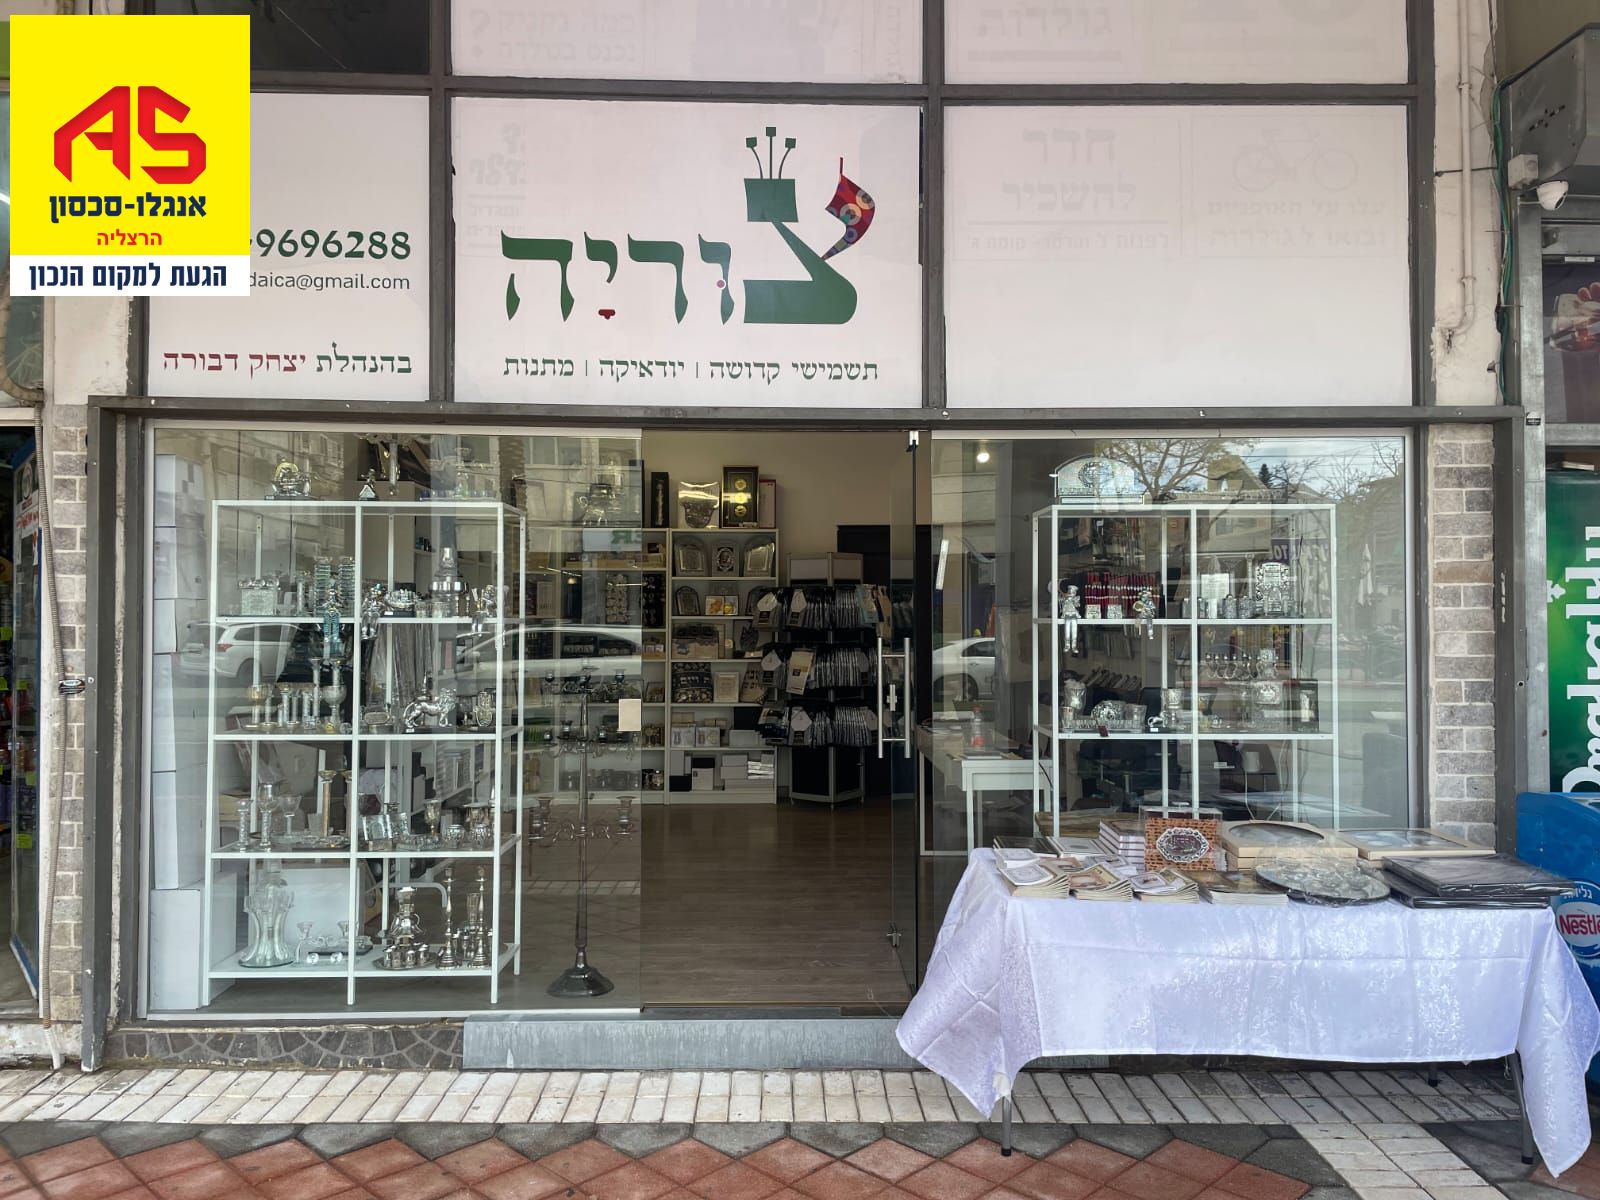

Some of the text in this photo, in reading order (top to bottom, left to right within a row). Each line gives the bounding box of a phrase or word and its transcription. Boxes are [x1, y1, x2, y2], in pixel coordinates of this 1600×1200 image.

[250, 228, 411, 260] 9696288
[163, 341, 412, 380] בהנהלת יצחק דבורה
[503, 357, 878, 385] תשמישי קדושה יודאיקה מתנות
